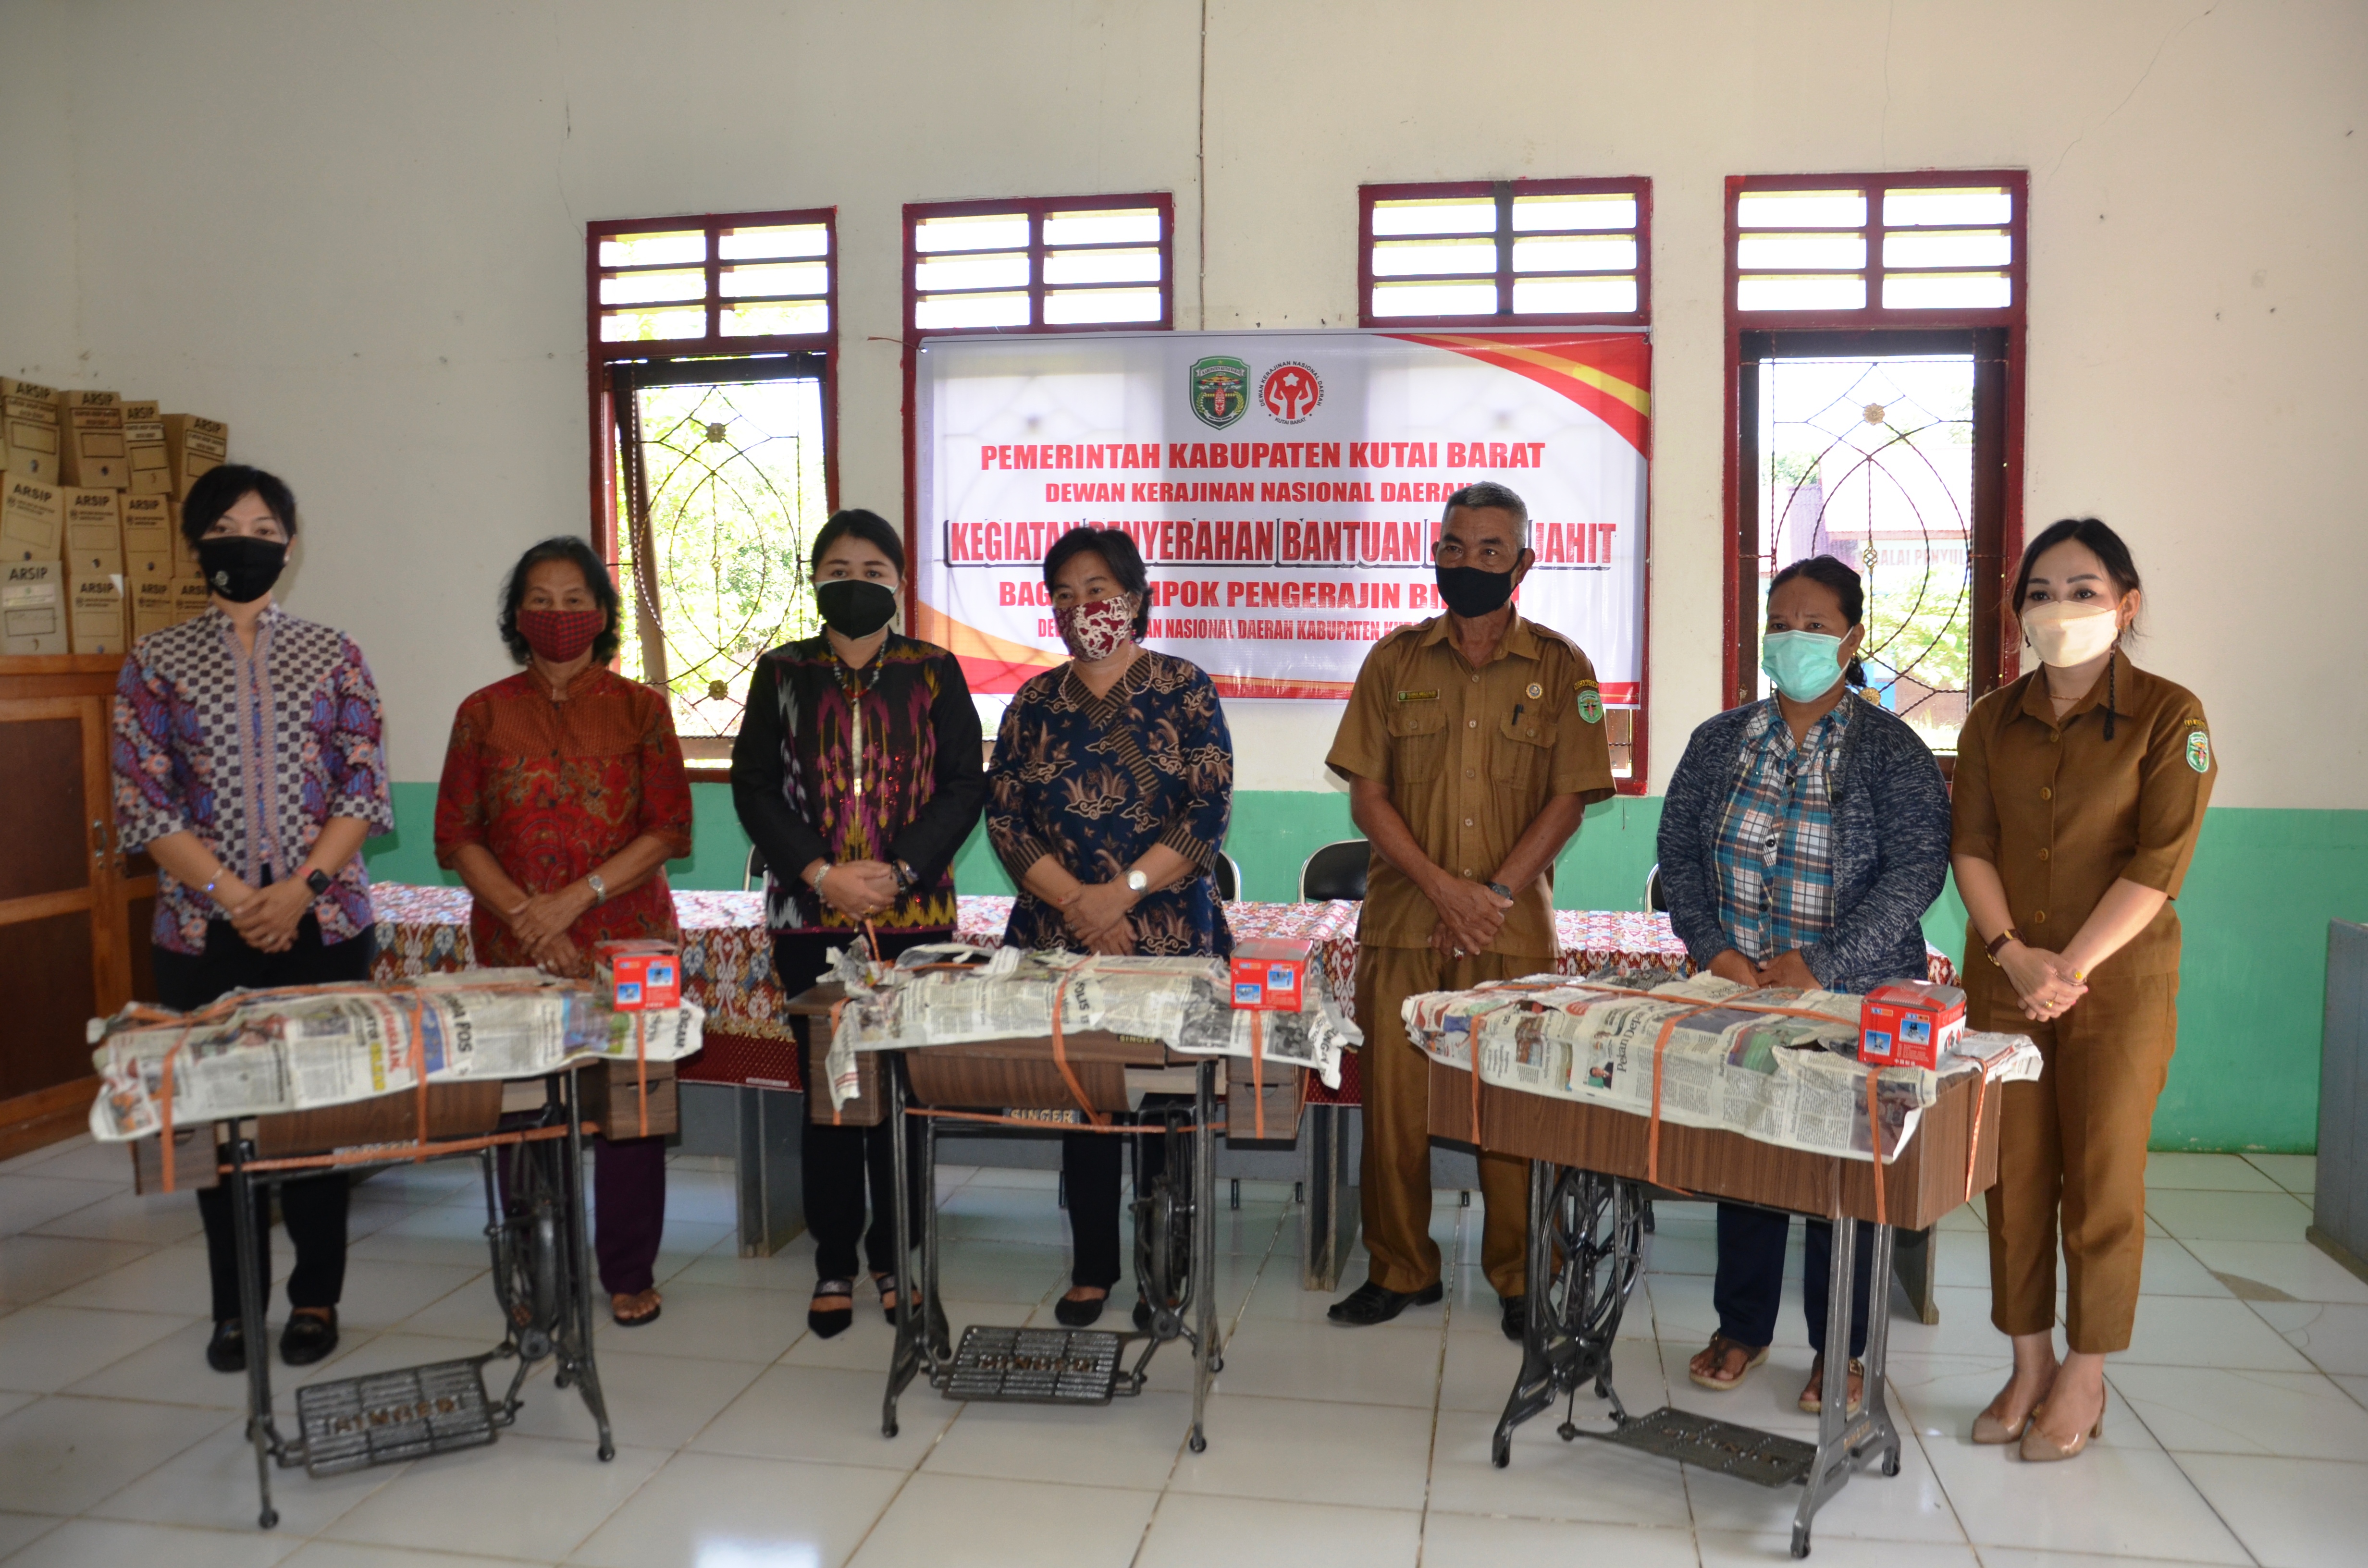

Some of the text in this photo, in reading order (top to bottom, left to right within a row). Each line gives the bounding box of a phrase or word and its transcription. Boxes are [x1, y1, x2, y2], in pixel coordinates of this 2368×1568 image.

[1262, 361, 1291, 383] KERAJINAN
[1293, 361, 1319, 380] NASIONAL
[981, 441, 1546, 470] PEMERINTAH KABUPATEN KUTAI BARAT
[13, 484, 52, 502] ARSIP
[1046, 481, 1473, 502] DEWAN KERAJINAN NASIONAL DAERA
[75, 495, 110, 506] ARSIP
[129, 499, 160, 510] ARSIP
[951, 521, 1080, 561] KEGIATA
[1282, 521, 1421, 562] BANTUAN
[1534, 522, 1616, 563] JAHIT
[1878, 549, 1910, 565] ALAI
[9, 567, 48, 581] ARSIP
[80, 582, 114, 594] ARSIP
[141, 584, 167, 594] ARSIP
[999, 581, 1052, 607] BAG
[1227, 581, 1400, 609] PENGERAJIN
[1165, 618, 1234, 639] NASIONAL
[1237, 619, 1294, 640] DAERAH
[1297, 620, 1380, 640] KABUPATEN
[1119, 1035, 1156, 1043] SINGER
[1616, 1038, 1629, 1074] Pekan
[1011, 1109, 1073, 1124] SINGER
